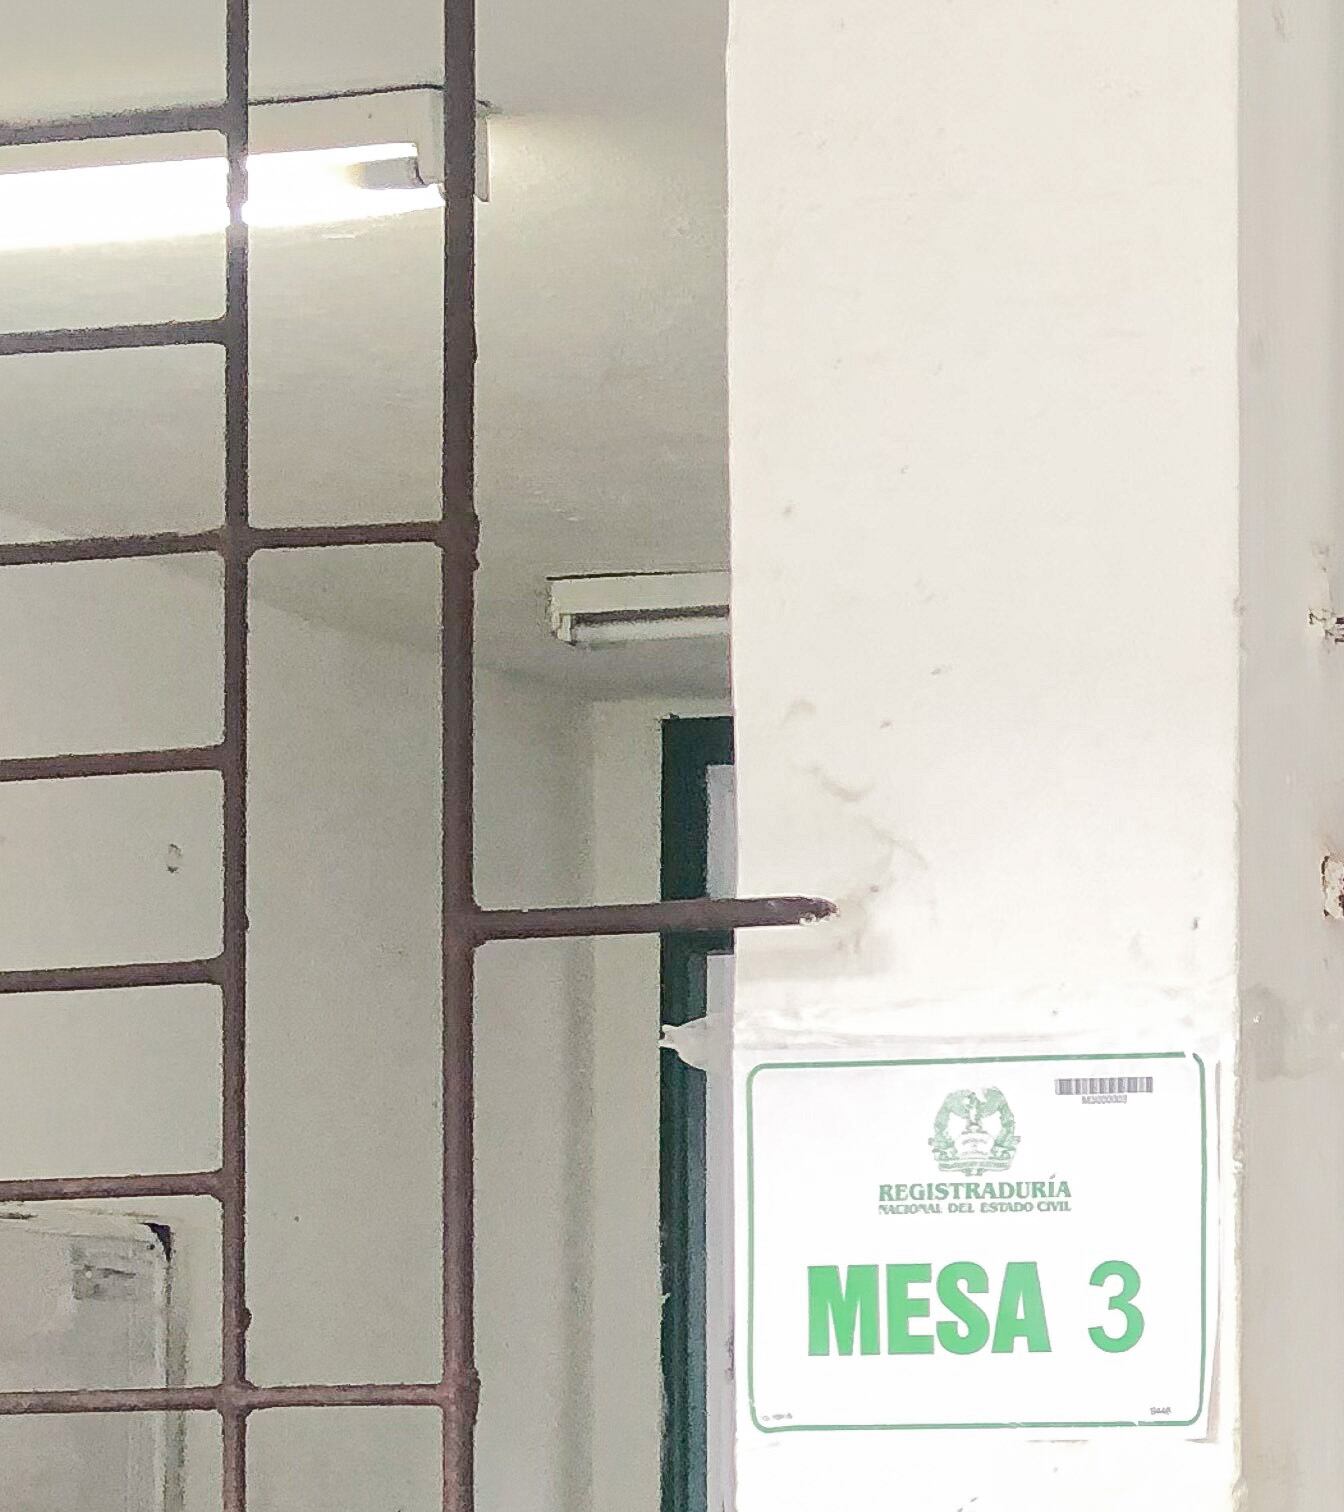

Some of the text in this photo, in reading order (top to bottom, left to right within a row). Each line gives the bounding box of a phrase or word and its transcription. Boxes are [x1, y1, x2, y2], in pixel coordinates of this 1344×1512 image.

[879, 1173, 1072, 1202] REGISTRADURÍA
[878, 1200, 1072, 1215] NACIONAL DEL ESTADO CIVIL
[807, 1260, 1145, 1356] MESA 3
